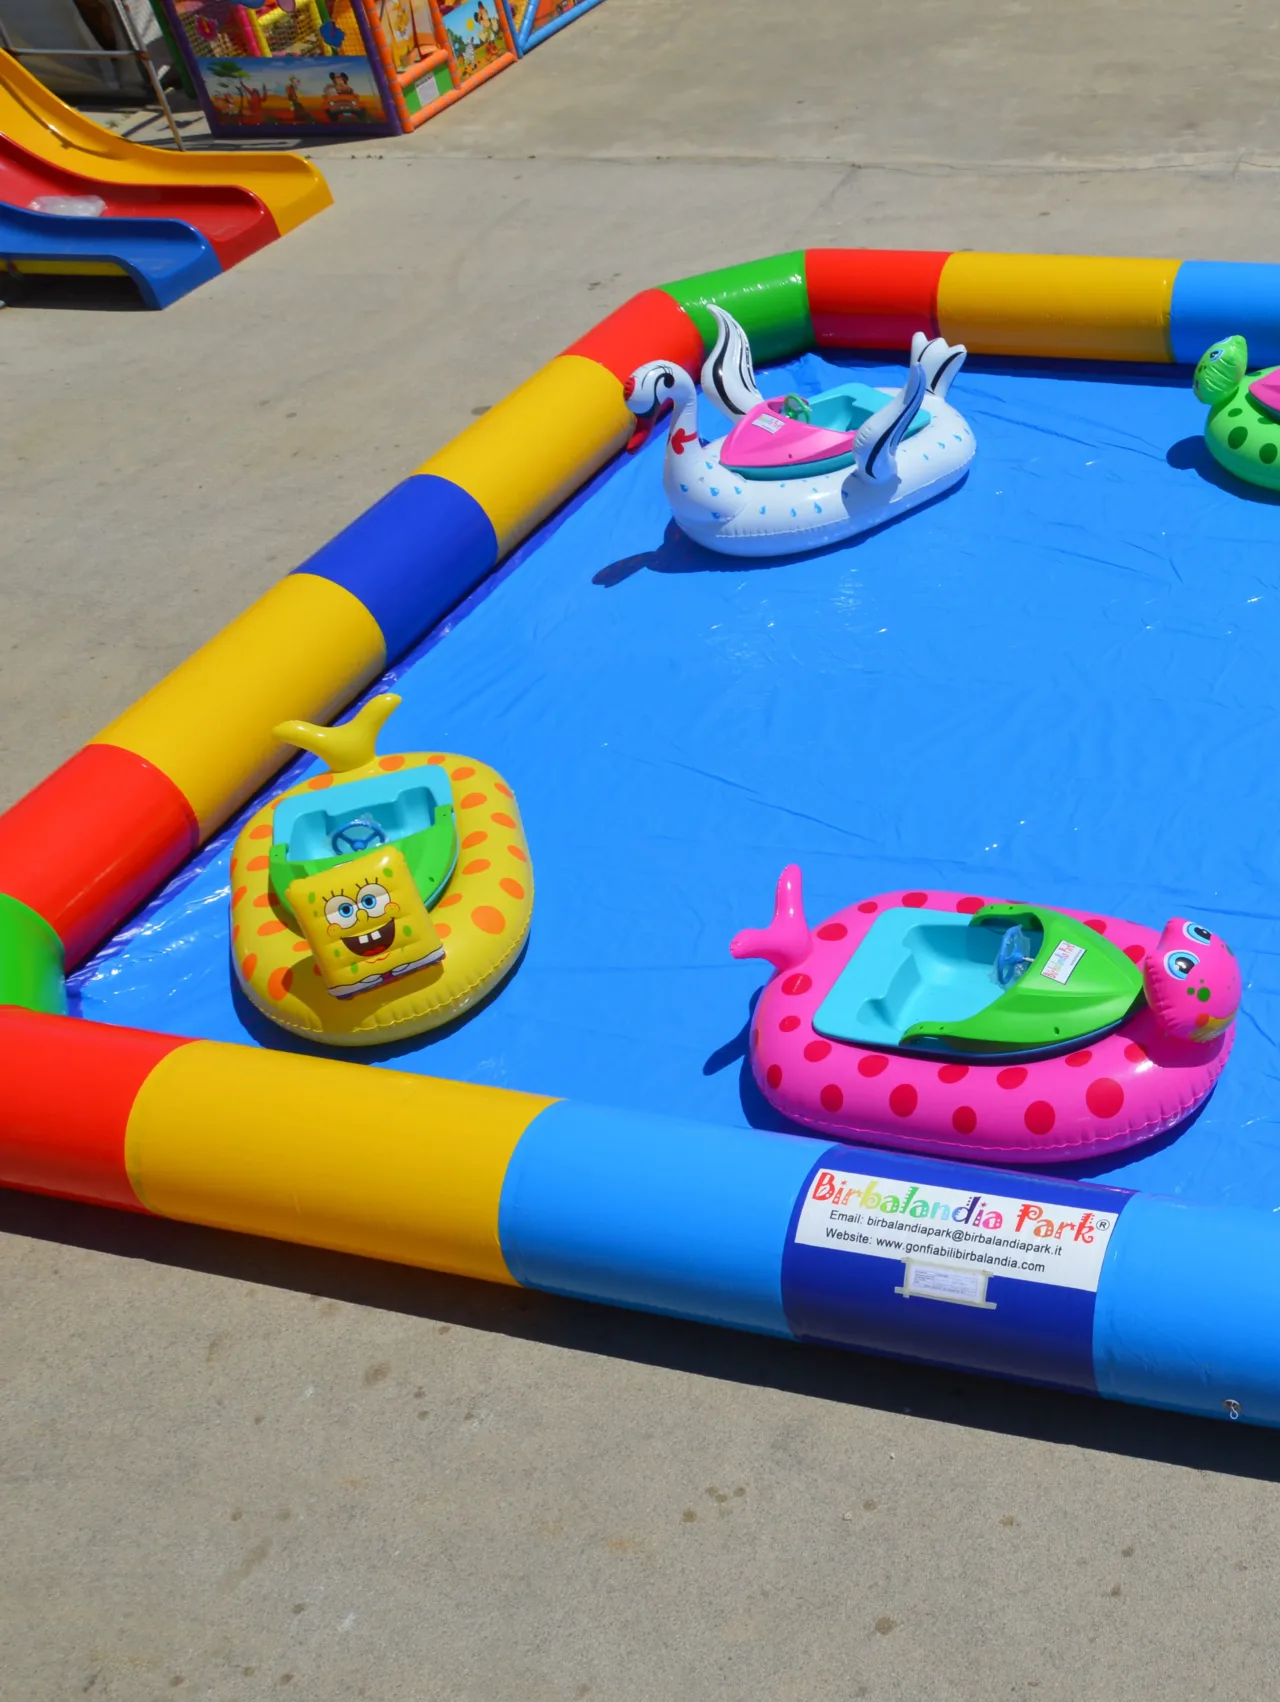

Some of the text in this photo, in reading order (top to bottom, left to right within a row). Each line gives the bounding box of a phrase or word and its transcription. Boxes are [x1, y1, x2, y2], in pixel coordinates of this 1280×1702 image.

[813, 1172, 1003, 1230] Birbalandia
[826, 1228, 1045, 1272] Website: www.gonfiabilibirbalandia.com
[830, 1210, 1062, 1256] Email: birbalandiapark@birbalandiapark.it
